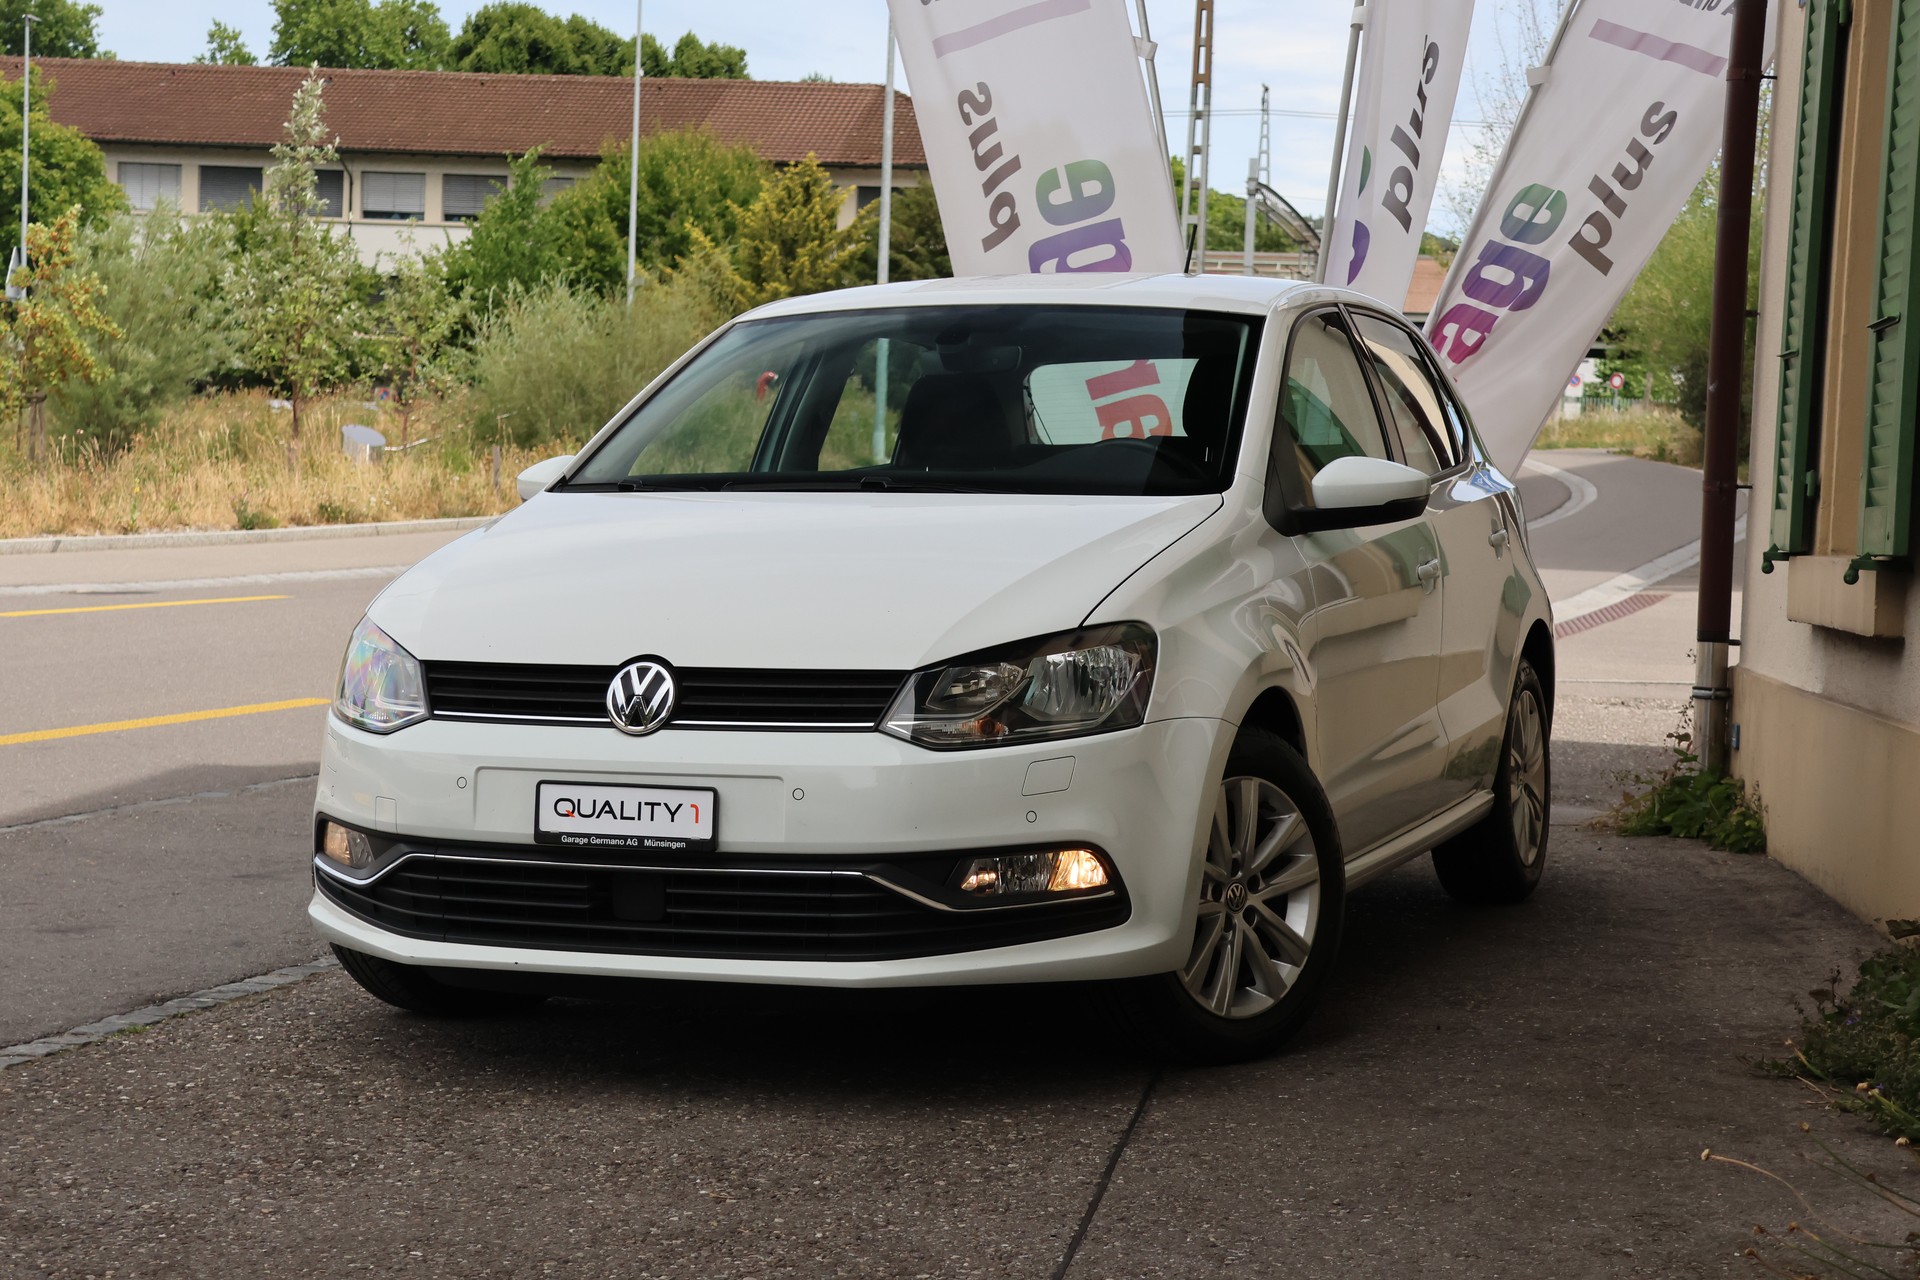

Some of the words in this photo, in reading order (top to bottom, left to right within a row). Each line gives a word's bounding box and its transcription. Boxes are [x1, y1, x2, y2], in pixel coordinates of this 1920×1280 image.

[1568, 101, 1678, 277] plus
[1430, 183, 1568, 366] age
[607, 662, 674, 734] VW
[554, 797, 683, 823] QUALITY
[690, 803, 700, 824] 1
[561, 835, 589, 845] Garage
[590, 837, 625, 846] Germano
[626, 838, 638, 846] AG
[644, 838, 686, 849] Münsingen
